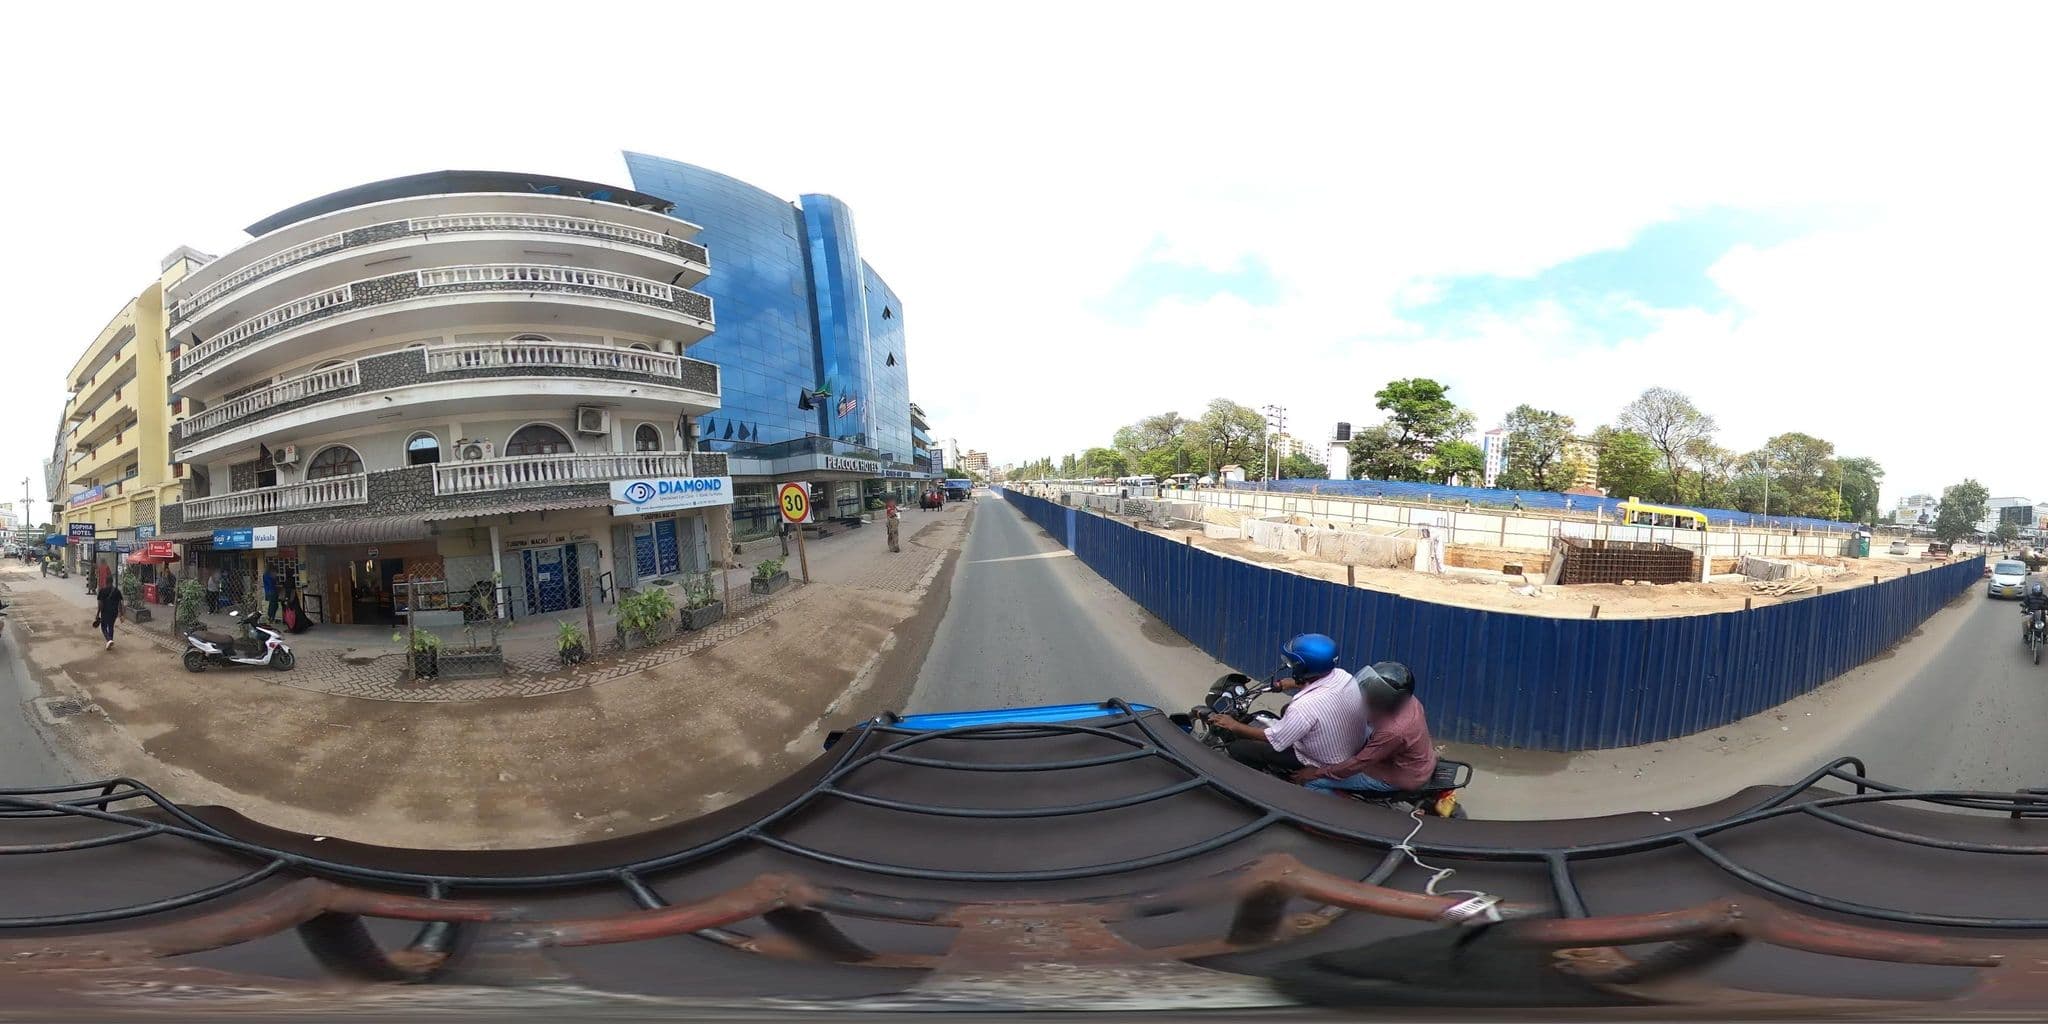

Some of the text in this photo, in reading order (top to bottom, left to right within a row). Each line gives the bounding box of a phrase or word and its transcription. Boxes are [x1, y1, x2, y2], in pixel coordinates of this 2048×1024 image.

[659, 479, 721, 494] DIAMOND
[784, 494, 803, 511] 30
[254, 533, 275, 542] Wakala
